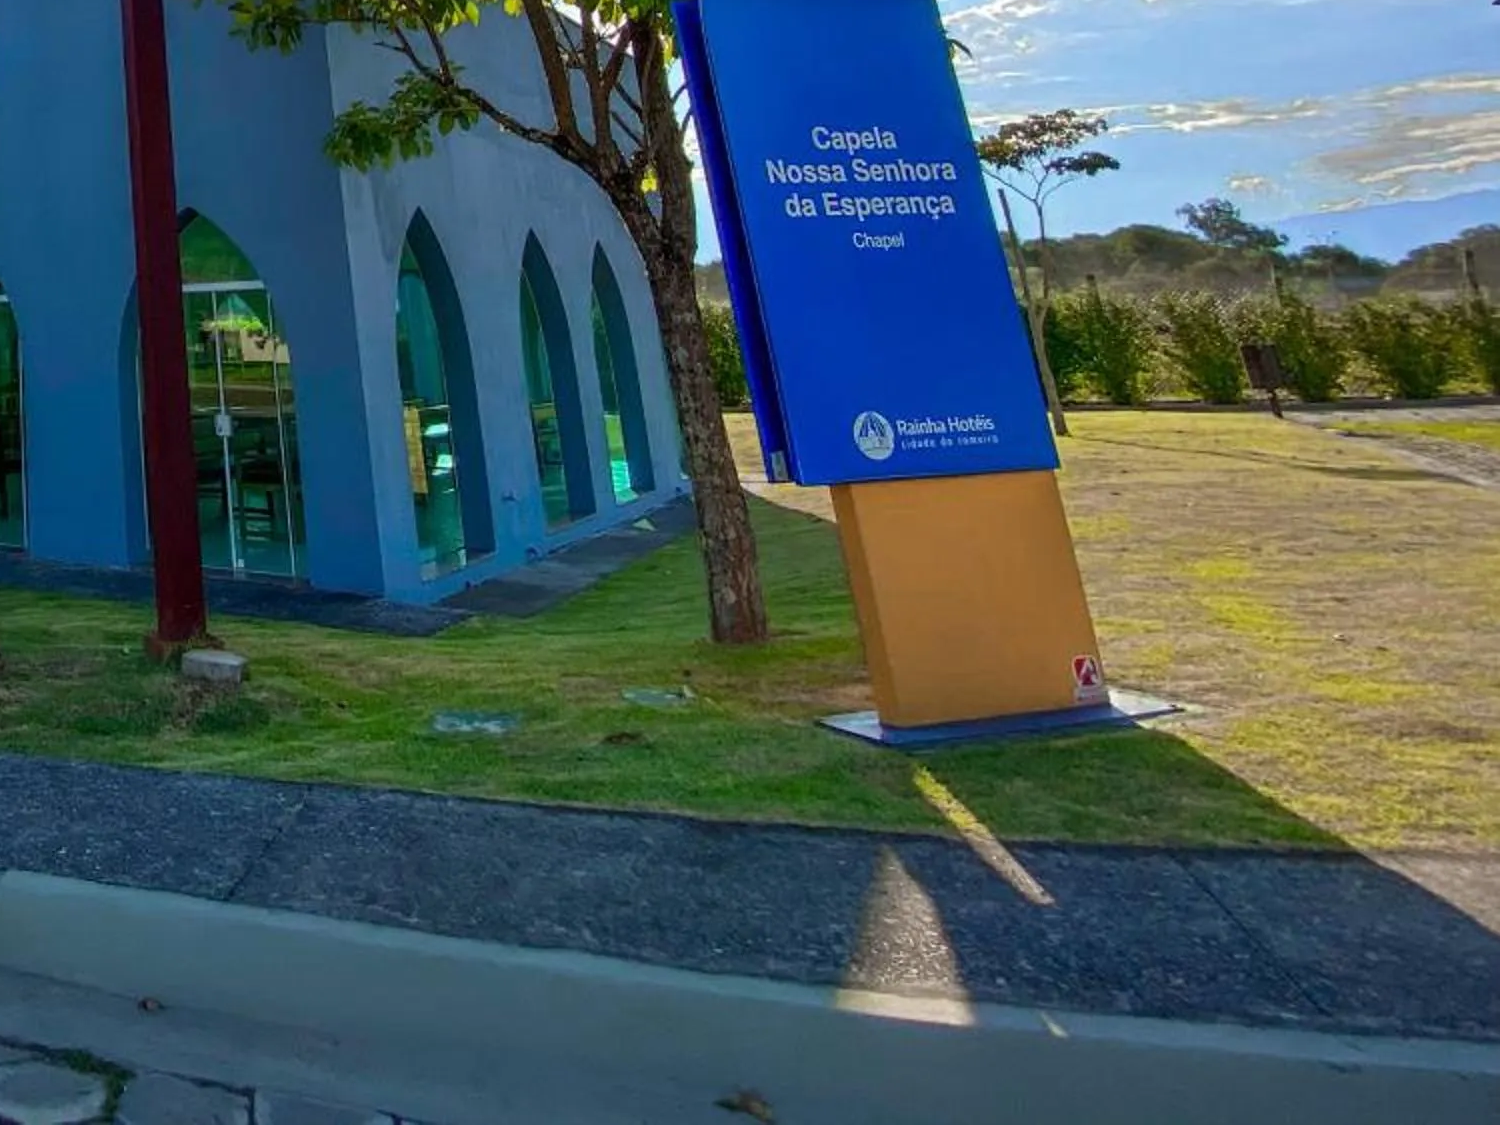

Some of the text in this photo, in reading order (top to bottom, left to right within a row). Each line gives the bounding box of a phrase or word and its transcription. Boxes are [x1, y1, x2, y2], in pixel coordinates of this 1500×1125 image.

[811, 126, 897, 155] Capela
[765, 158, 957, 184] Nossa Senhora
[785, 192, 956, 222] da Esperança
[852, 232, 905, 251] Chapel
[896, 417, 946, 435] Rainha
